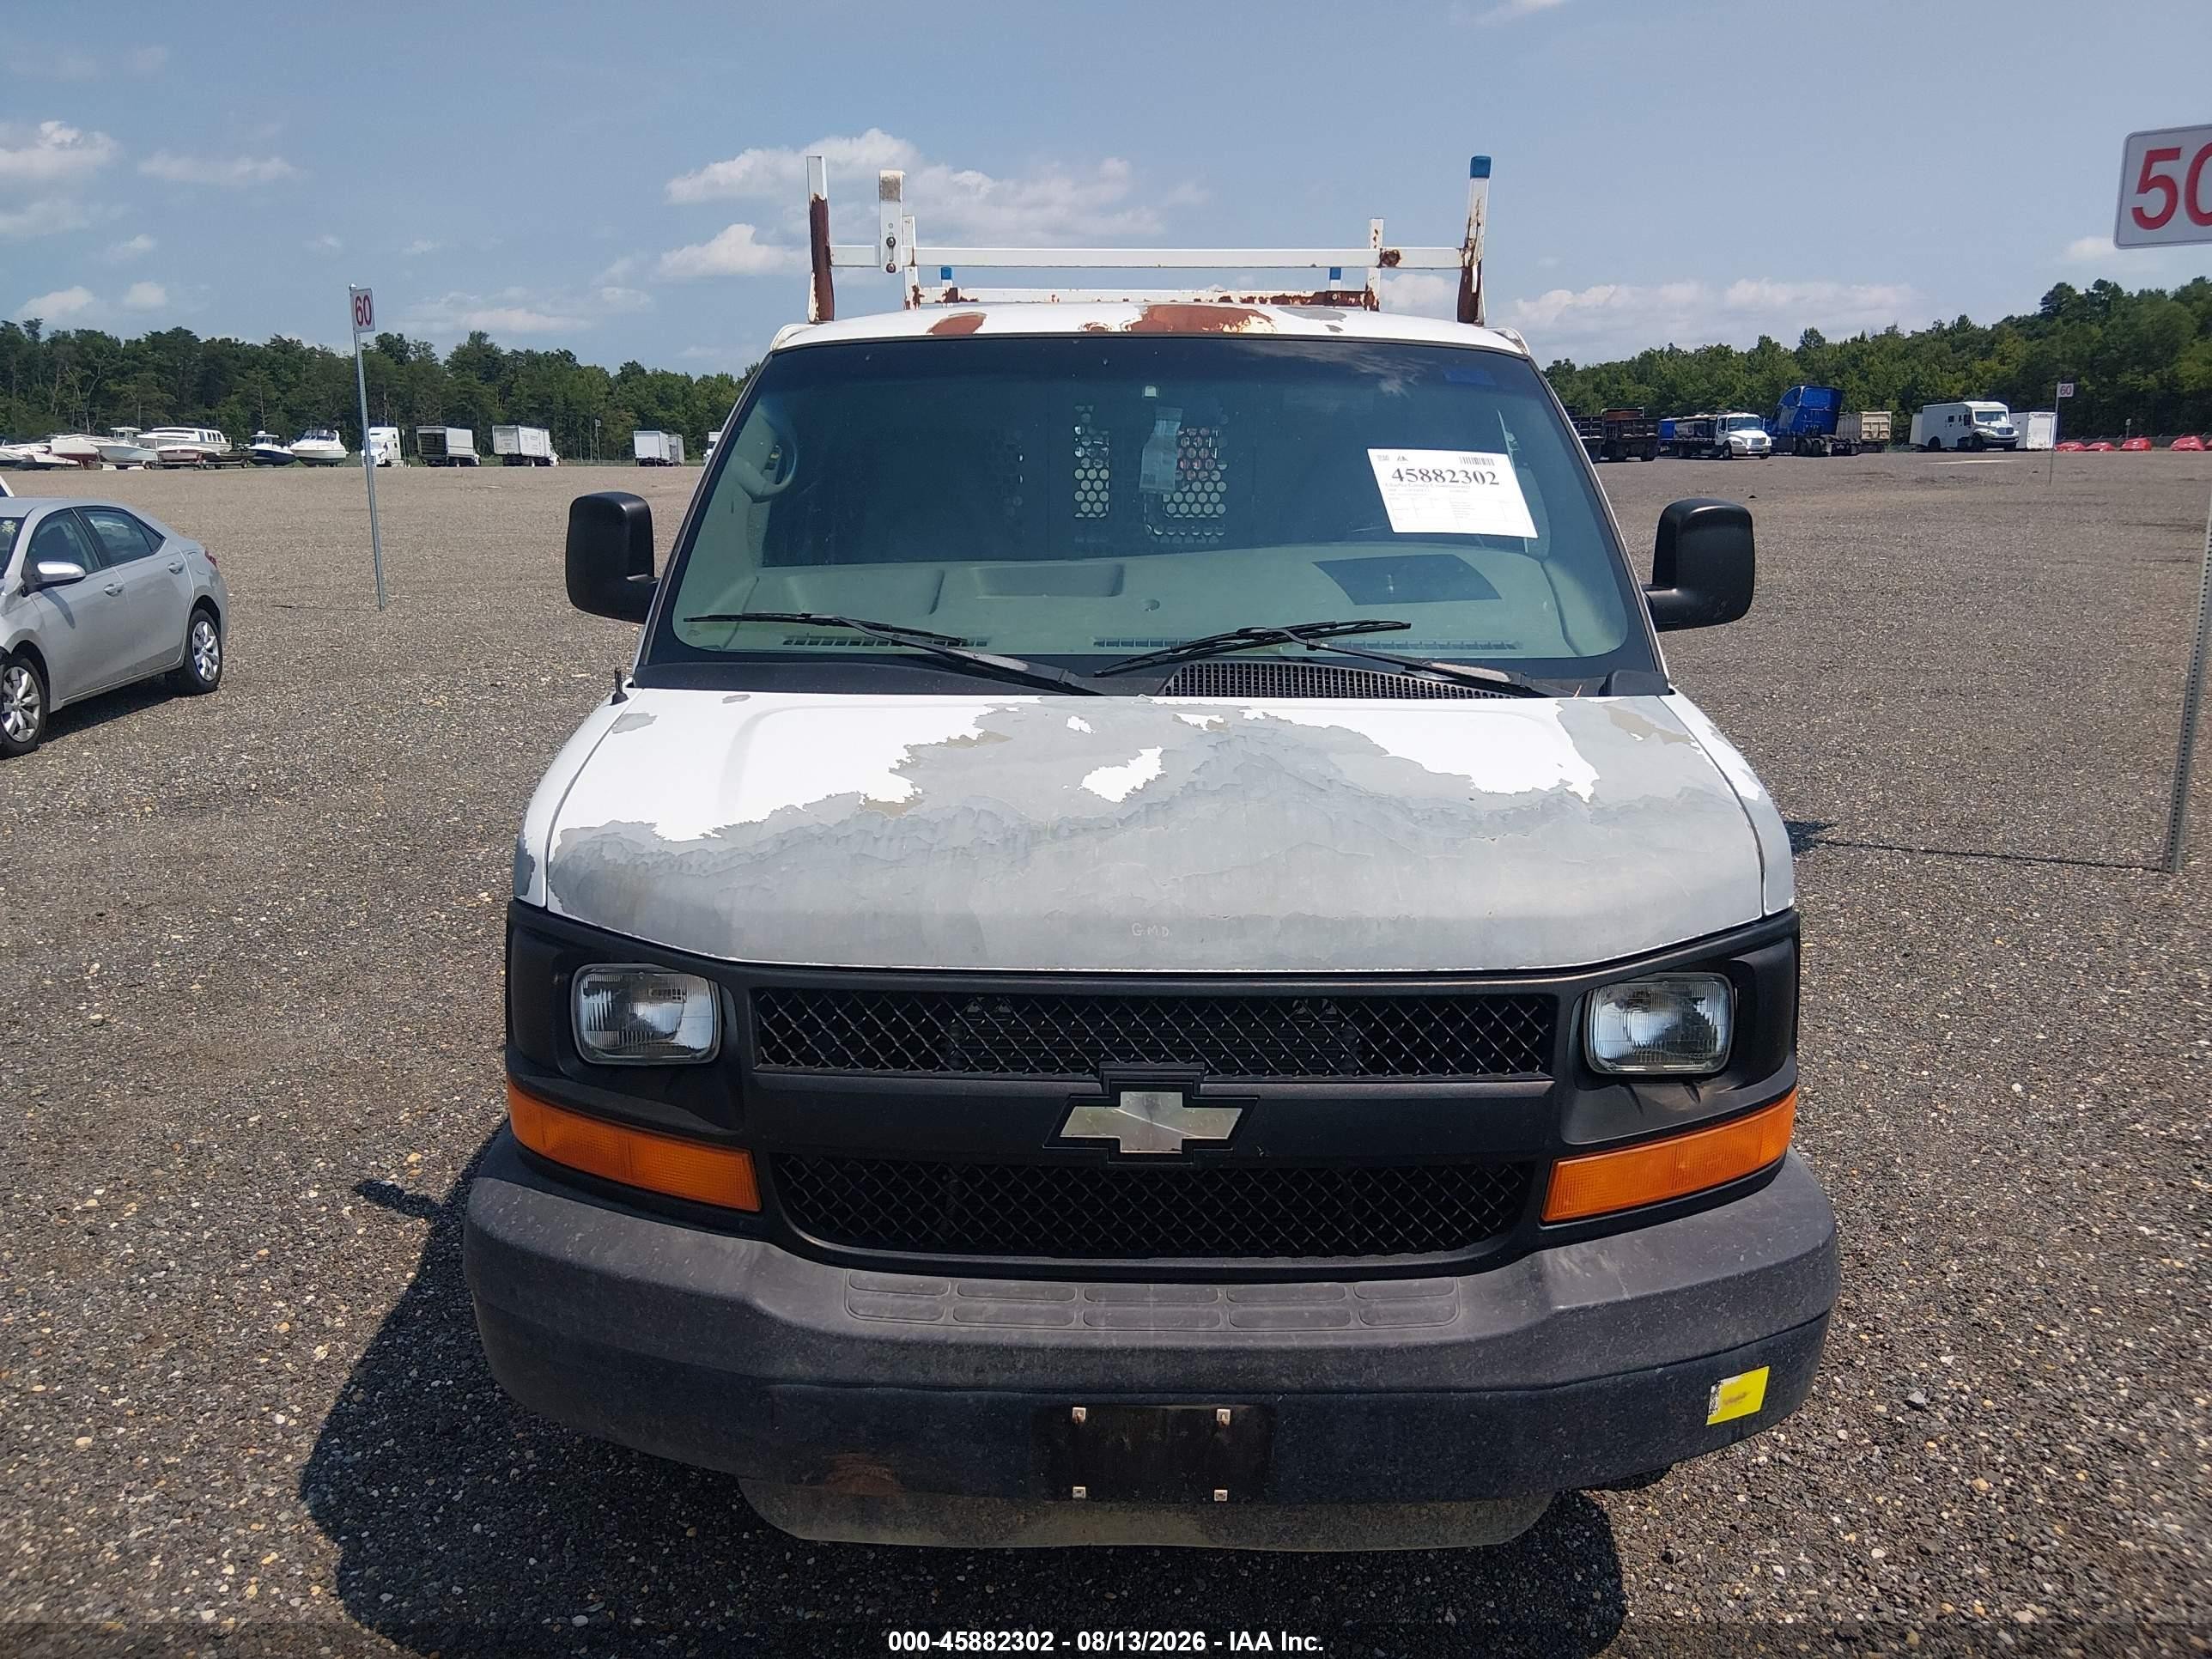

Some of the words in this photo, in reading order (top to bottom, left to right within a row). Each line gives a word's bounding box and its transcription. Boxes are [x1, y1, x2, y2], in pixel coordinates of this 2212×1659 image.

[355, 295, 372, 327] 60
[2060, 385, 2072, 396] 60
[1391, 467, 1500, 486] 45882302
